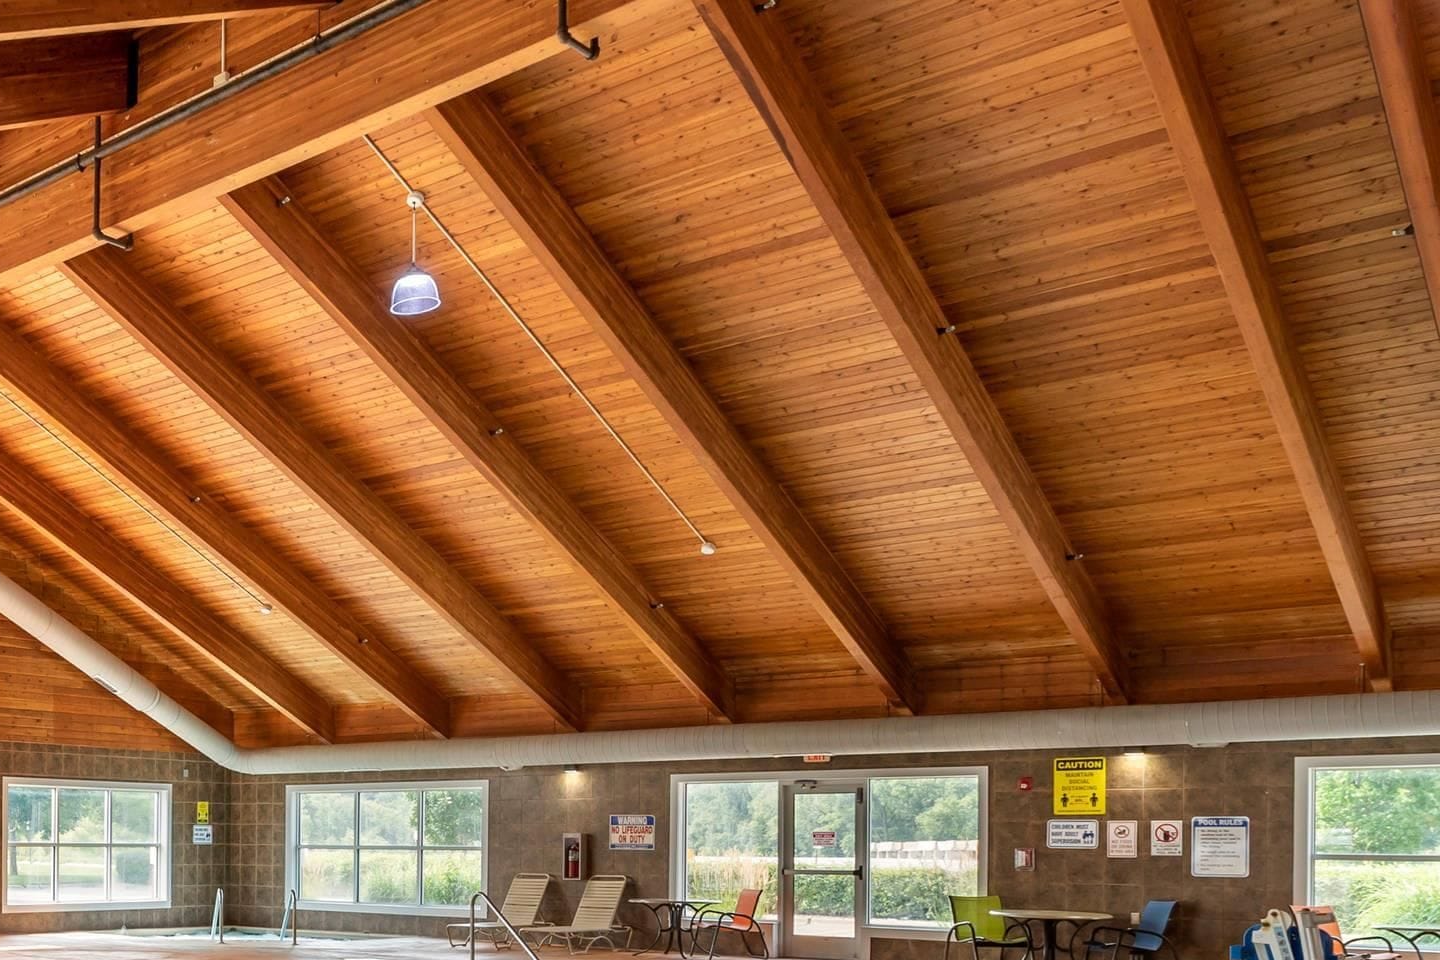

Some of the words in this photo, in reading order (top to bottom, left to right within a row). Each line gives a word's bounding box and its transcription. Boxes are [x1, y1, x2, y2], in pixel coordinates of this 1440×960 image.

[1058, 761, 1102, 769] CAUTION
[617, 816, 648, 825] WARNING
[622, 826, 653, 834] LIFEGUARD
[618, 835, 627, 843] ON
[630, 835, 645, 843] DUTY
